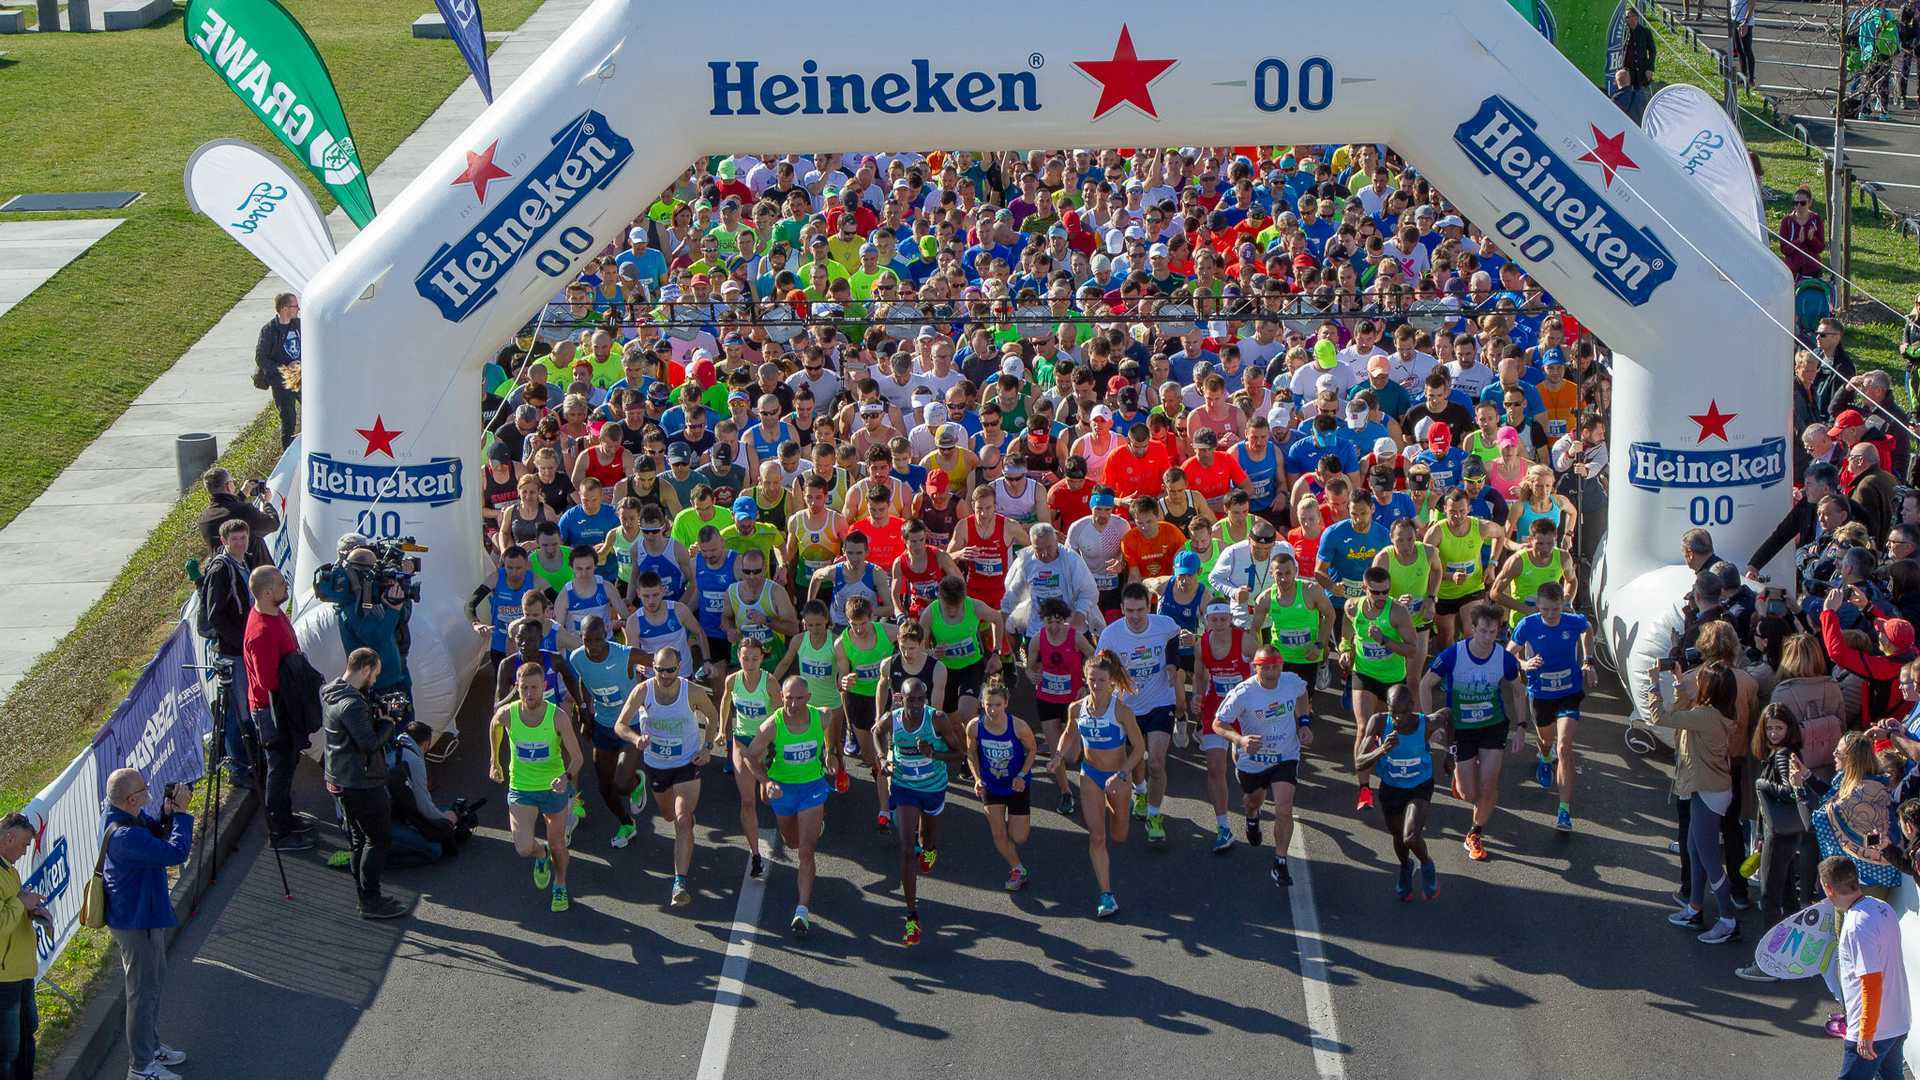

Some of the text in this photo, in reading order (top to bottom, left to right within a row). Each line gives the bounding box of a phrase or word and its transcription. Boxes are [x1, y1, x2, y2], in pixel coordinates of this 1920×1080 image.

[708, 59, 1042, 115] Heineken
[1252, 55, 1334, 113] 0.0
[1470, 110, 1655, 291] Heineken
[430, 134, 616, 308] Heineken
[1494, 211, 1554, 263] 0.0
[534, 225, 595, 278] 0.0
[311, 461, 455, 499] Heineken
[1635, 449, 1781, 483] Heineken
[1690, 495, 1734, 527] 0.0
[809, 666, 825, 675] 113
[1089, 728, 1101, 737] 12
[528, 749, 535, 758] 7
[793, 750, 811, 760] 109
[986, 749, 1010, 758] 1028
